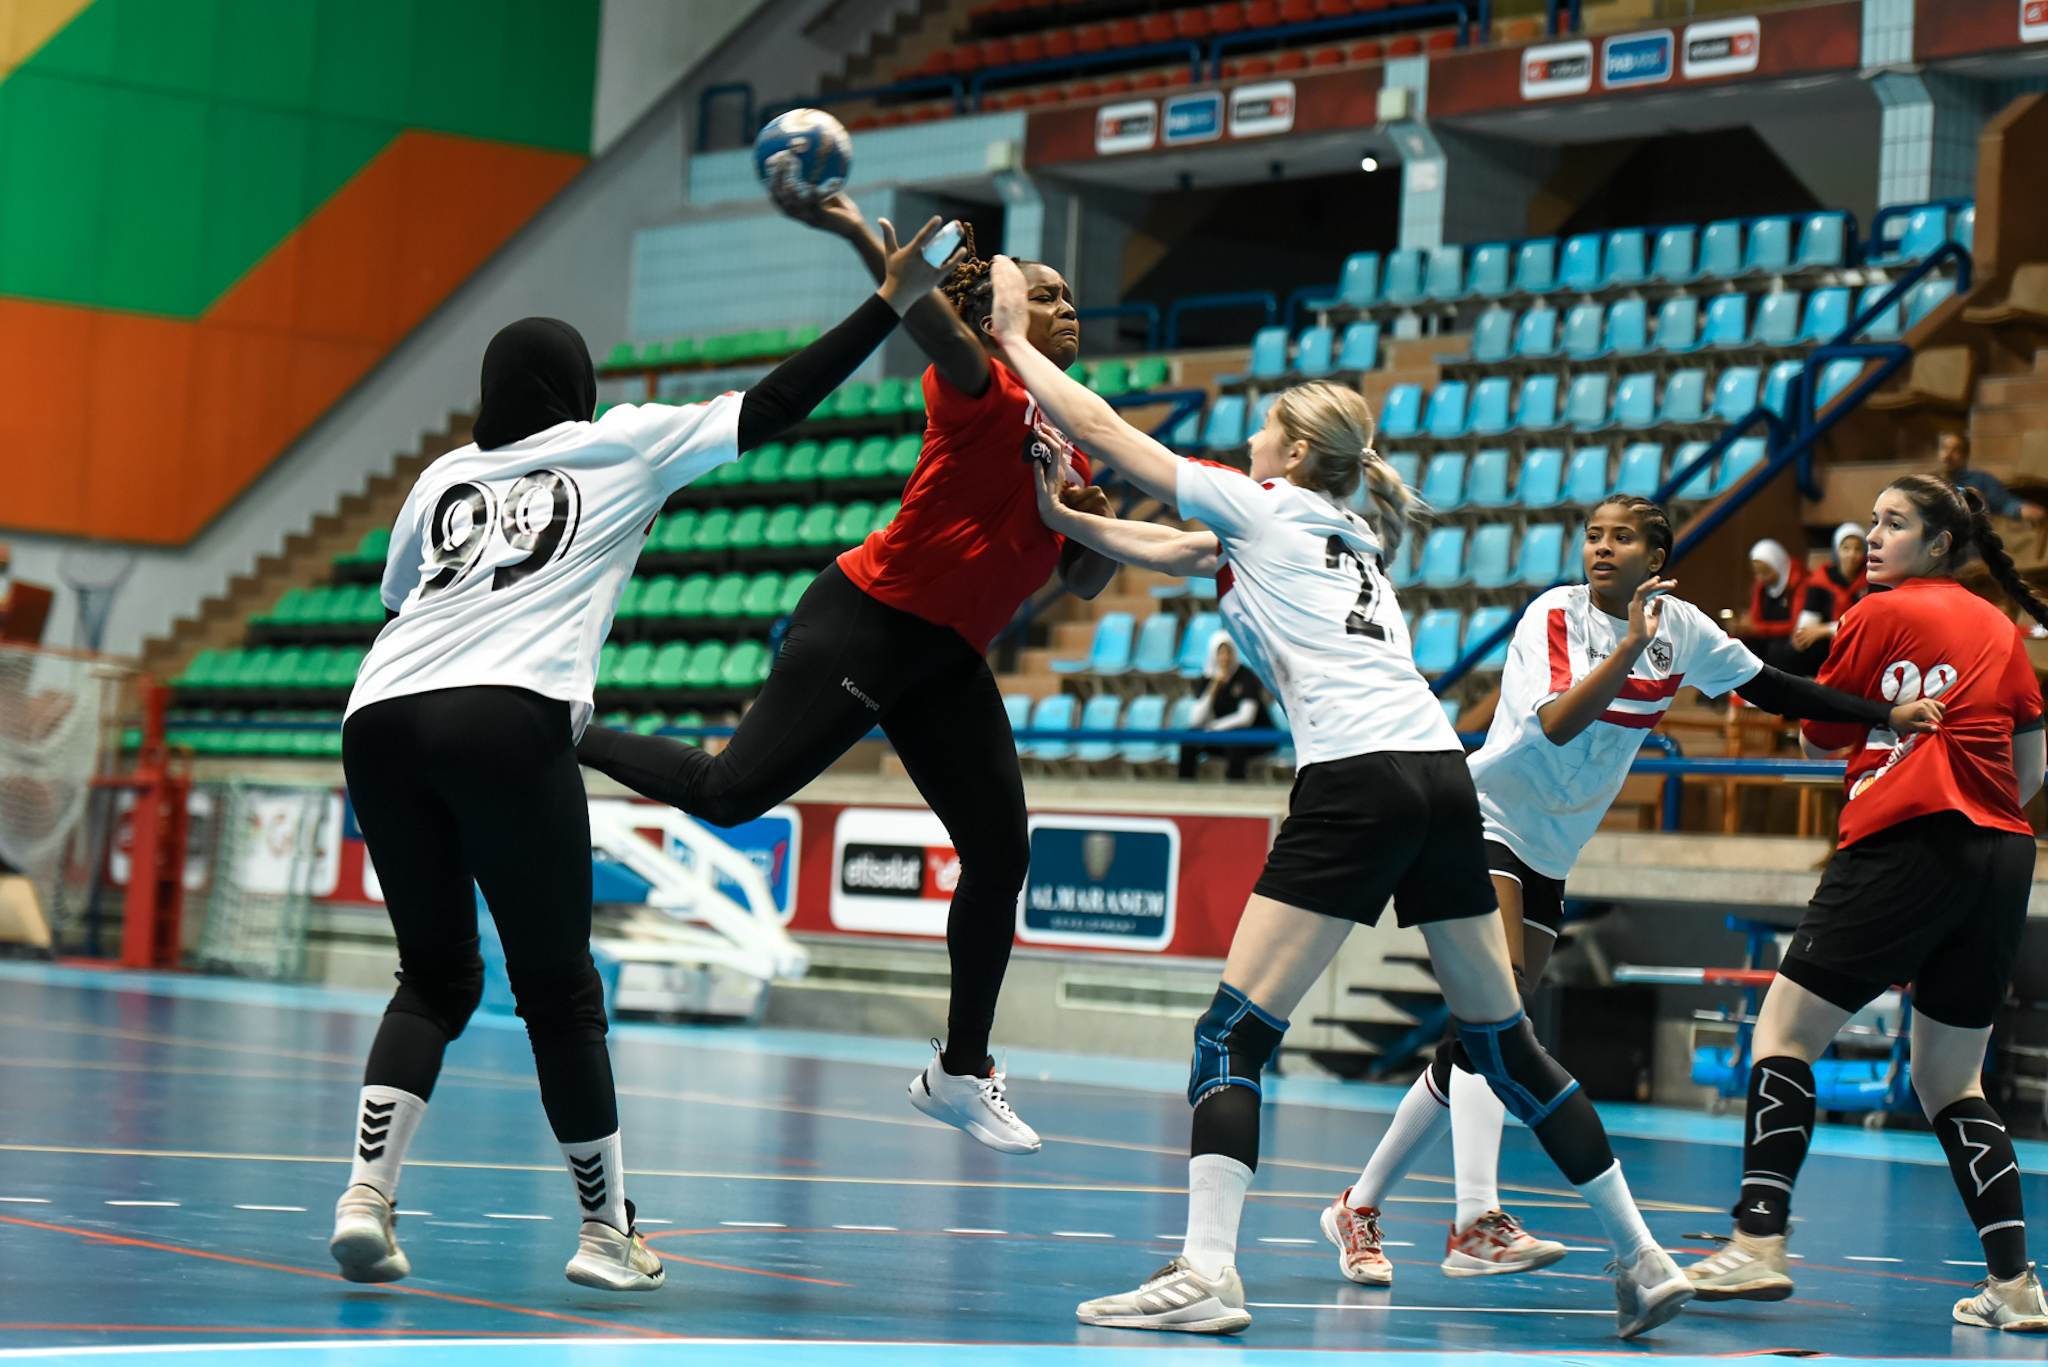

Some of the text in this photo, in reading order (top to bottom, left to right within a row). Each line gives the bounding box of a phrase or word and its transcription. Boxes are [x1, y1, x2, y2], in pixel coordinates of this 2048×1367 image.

[420, 468, 582, 600] 99
[1326, 534, 1386, 641] 2
[841, 677, 880, 711] Kempa
